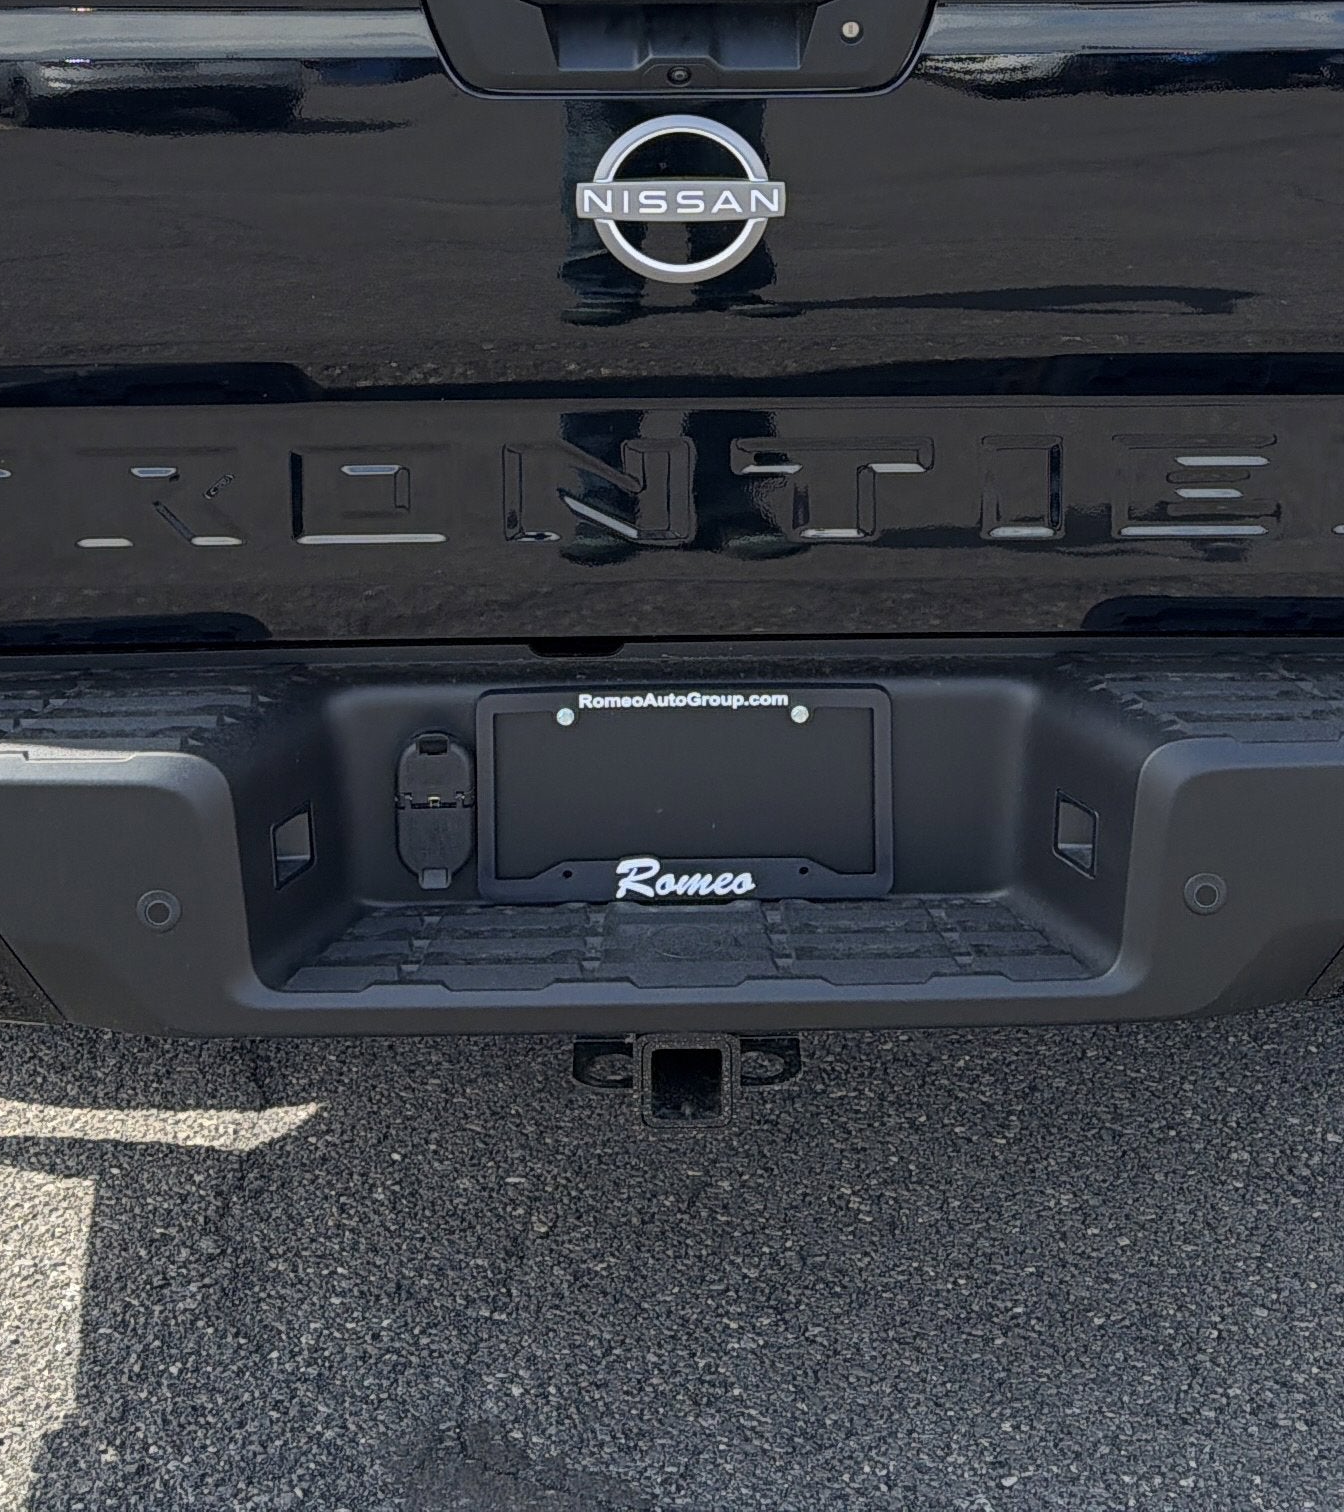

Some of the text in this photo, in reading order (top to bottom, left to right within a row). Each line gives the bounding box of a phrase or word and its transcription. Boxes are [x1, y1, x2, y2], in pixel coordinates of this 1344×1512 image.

[583, 188, 779, 214] NISSAN
[578, 692, 789, 710] RomeoAutoGroup.com
[615, 857, 756, 899] Romeo
